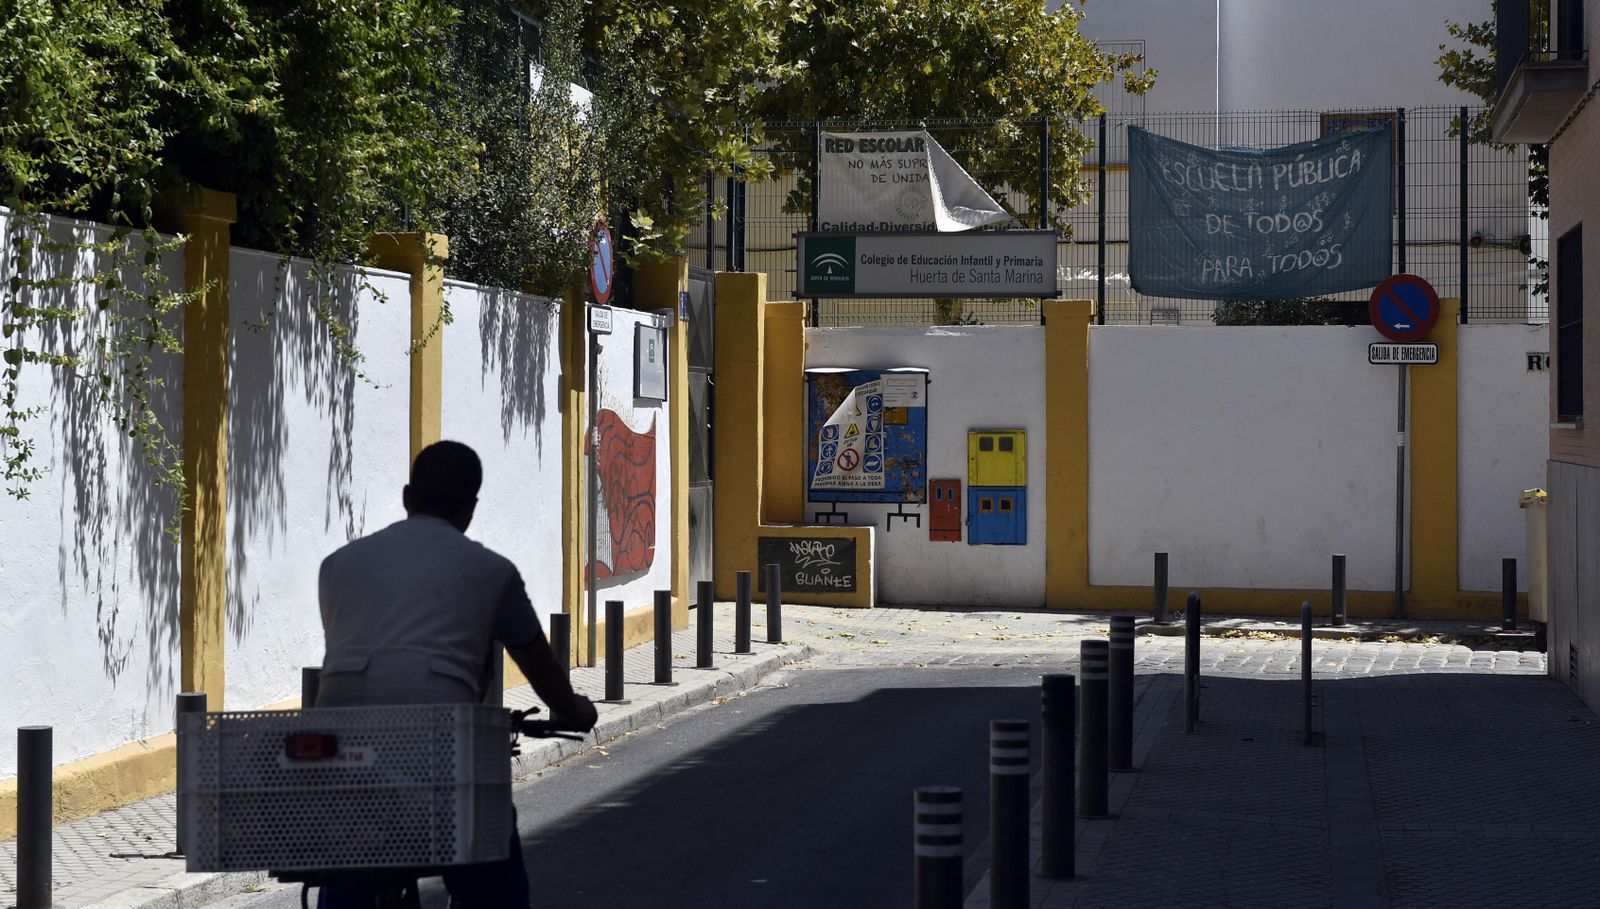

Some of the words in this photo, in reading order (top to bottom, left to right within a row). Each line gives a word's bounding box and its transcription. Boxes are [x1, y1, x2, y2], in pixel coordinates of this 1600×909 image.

[824, 137, 855, 153] RED
[858, 136, 925, 153] ESCOLAR
[848, 159, 864, 169] NO
[870, 155, 893, 169] MÁS
[898, 158, 928, 169] SUPR
[1161, 161, 1263, 192] ESCUELA
[1272, 149, 1363, 191] PÚBLICA
[871, 174, 887, 184] DE
[892, 173, 930, 184] UNIDA
[1206, 213, 1240, 235] DE
[860, 253, 895, 268] Colegio
[897, 254, 908, 266] de
[911, 254, 958, 266] Educación
[961, 255, 993, 267] Infantil
[995, 257, 1001, 268] y
[1003, 255, 1043, 267] Primaria
[910, 269, 948, 284] Huerta
[952, 269, 966, 284] de
[968, 269, 1001, 284] Santa
[1005, 269, 1043, 284] Marina
[1202, 256, 1254, 284] PARA
[1371, 346, 1391, 361] SALIDA
[1392, 346, 1400, 361] DE
[1401, 346, 1436, 361] EMERGENCIA
